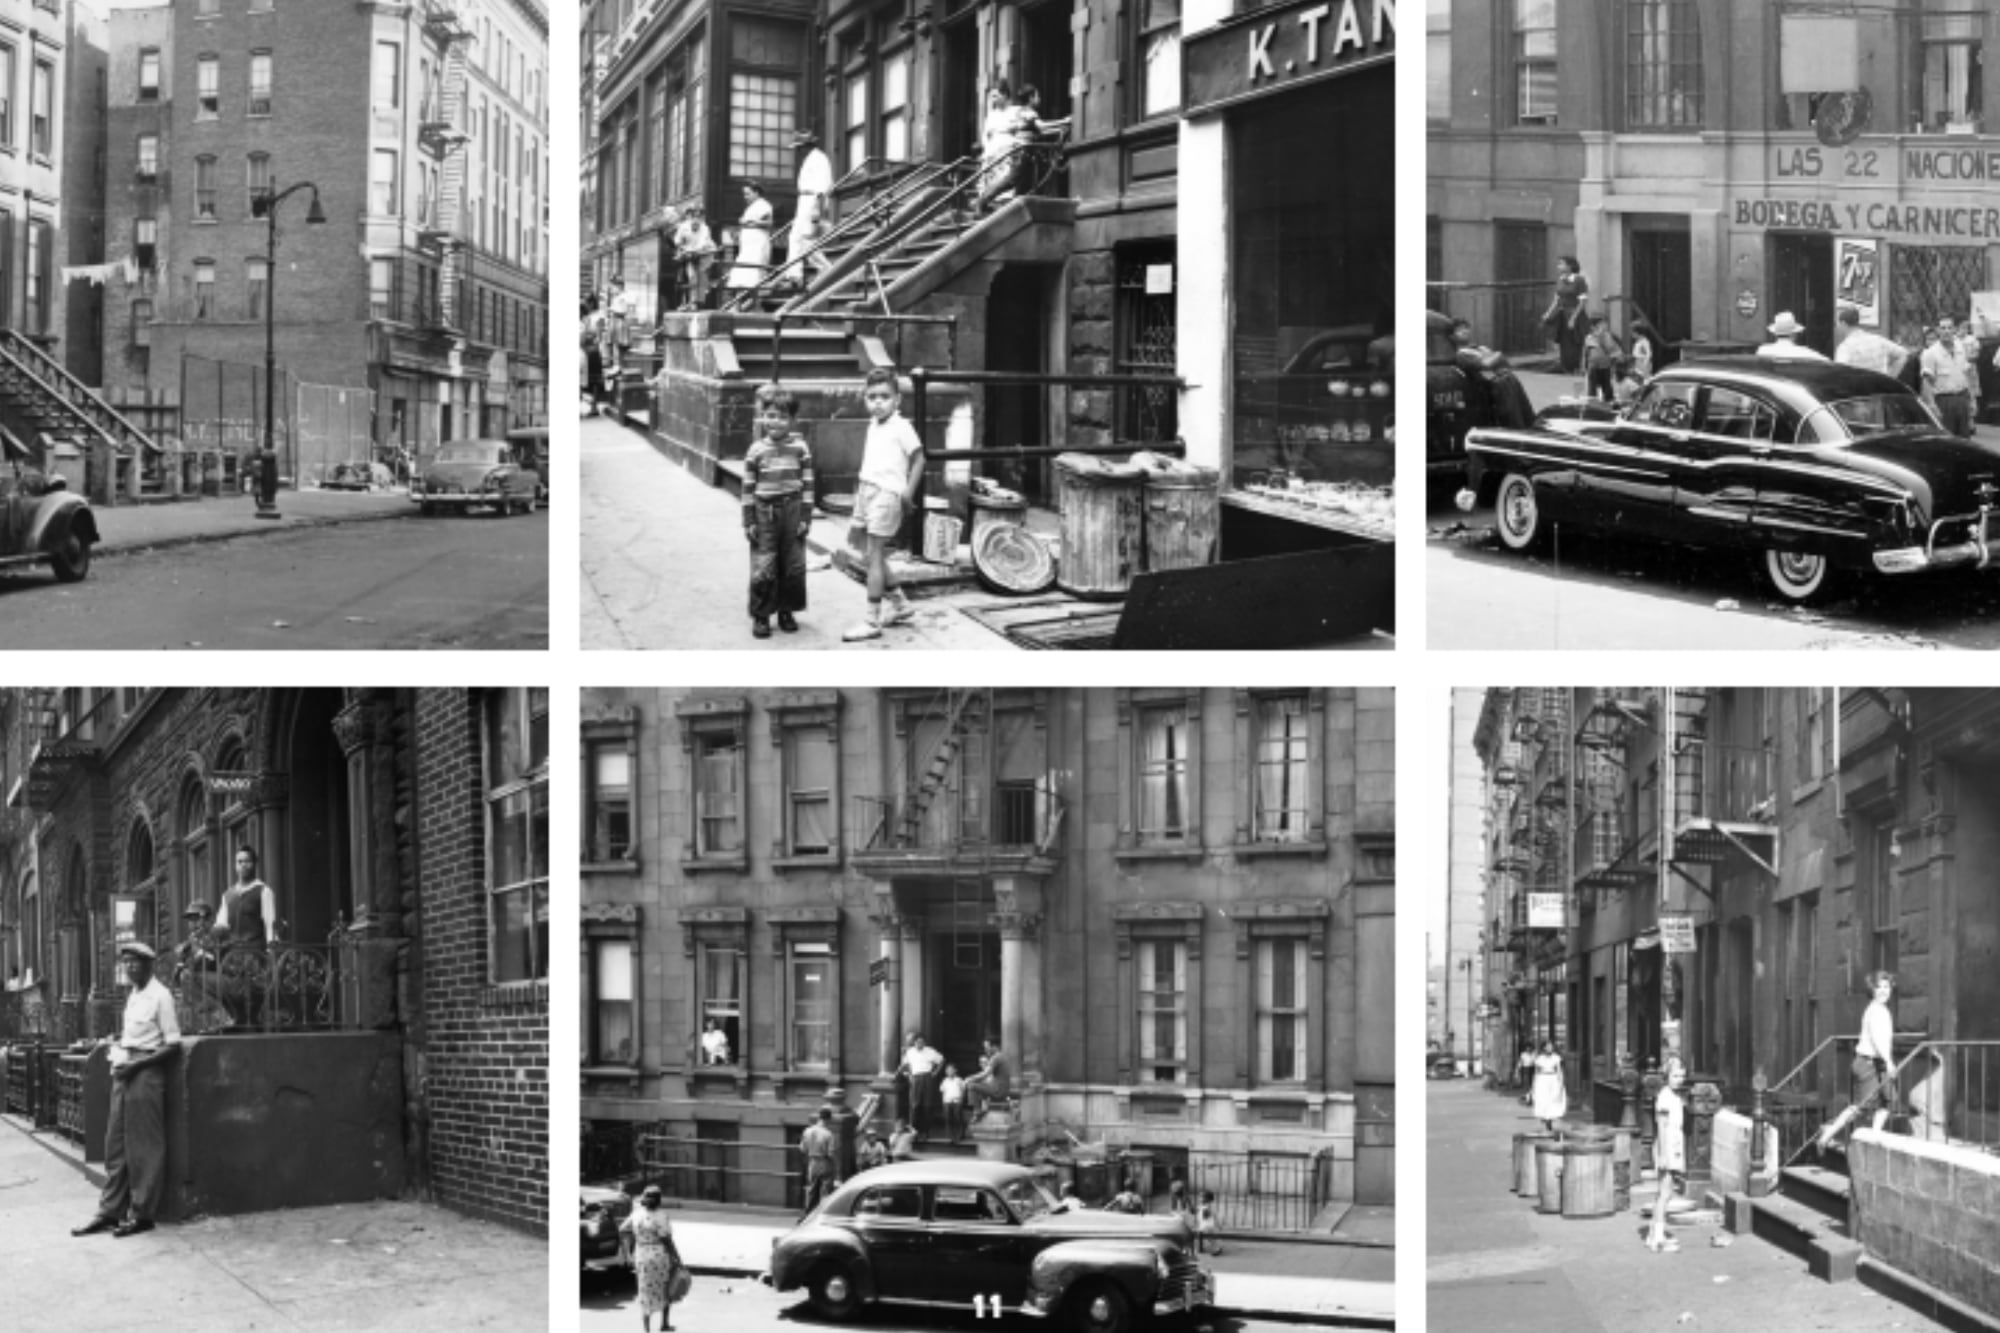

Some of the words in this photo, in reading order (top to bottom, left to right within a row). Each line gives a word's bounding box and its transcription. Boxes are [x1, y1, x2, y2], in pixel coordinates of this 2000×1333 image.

[1777, 148, 1823, 177] LAS
[1845, 150, 1879, 177] 22
[1907, 150, 2000, 181] NACIONE
[1735, 200, 1841, 229] BODEGA
[1846, 204, 1860, 230] Y
[1867, 203, 2000, 238] CARNICER
